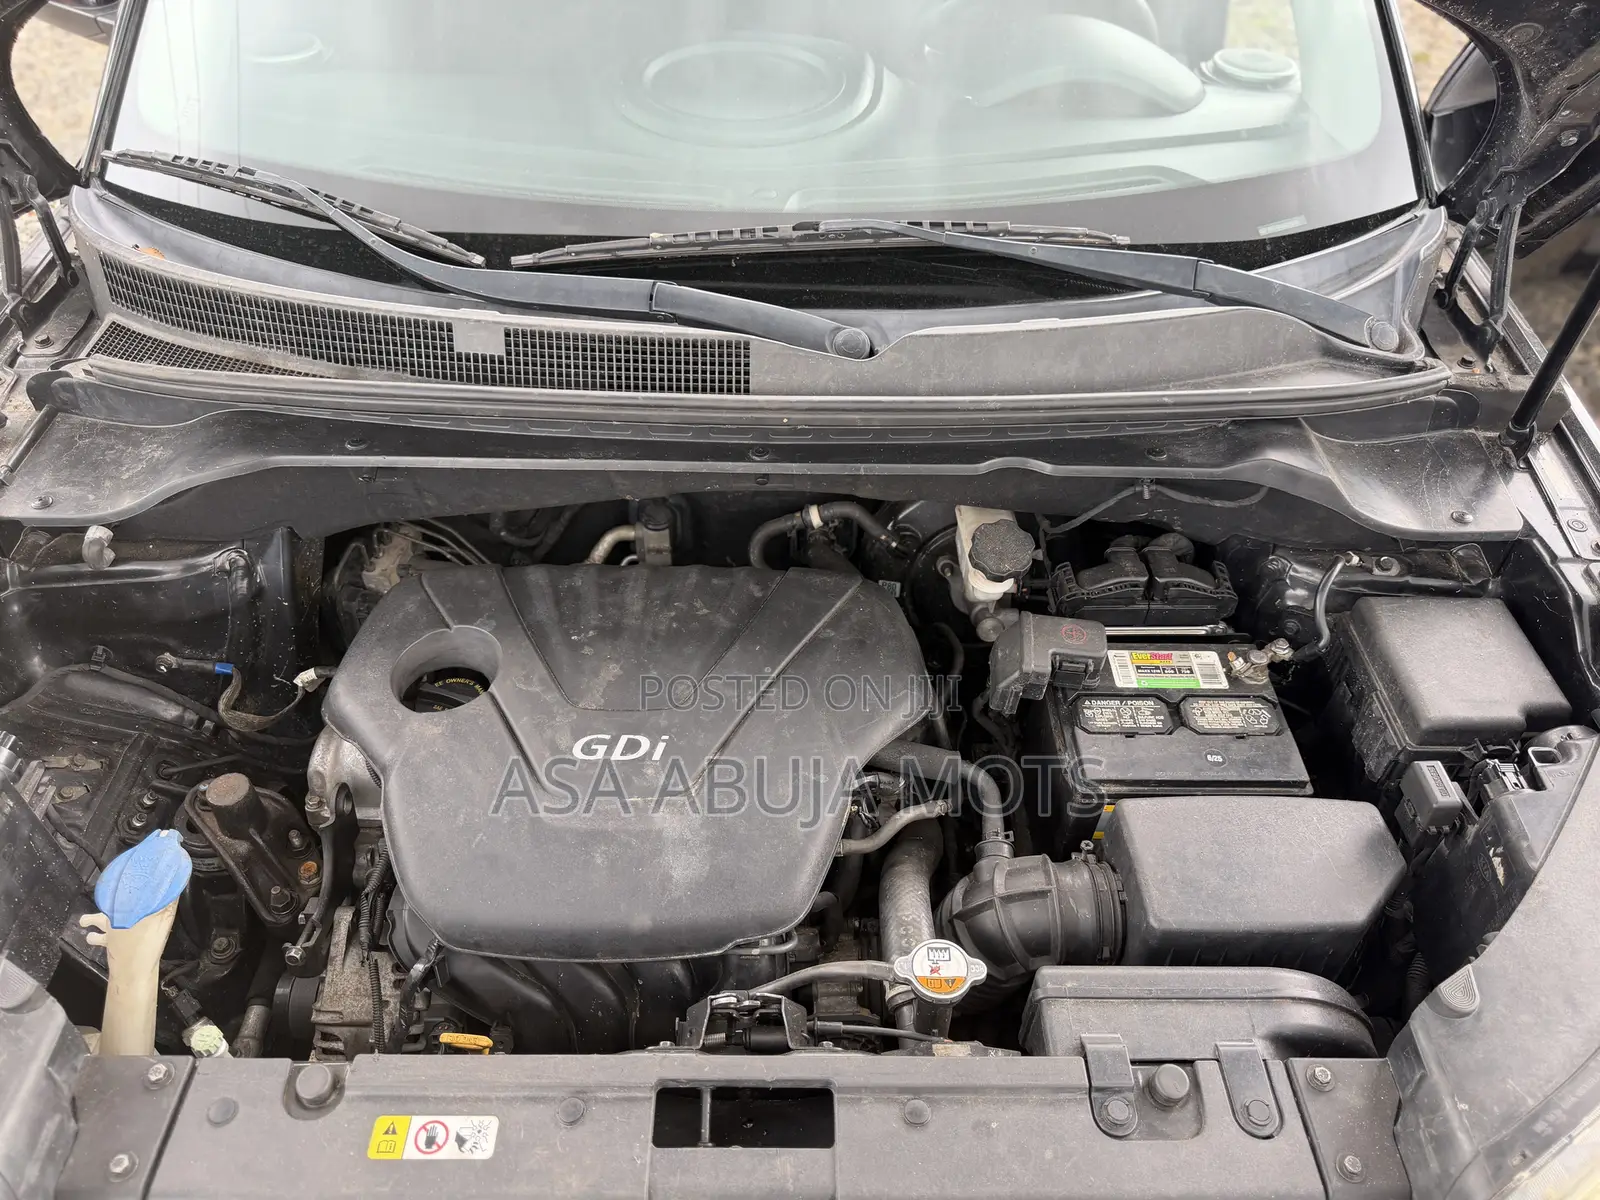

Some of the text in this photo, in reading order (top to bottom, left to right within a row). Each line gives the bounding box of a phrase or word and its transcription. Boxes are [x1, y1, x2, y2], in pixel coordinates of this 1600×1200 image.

[1131, 652, 1172, 660] EverStart
[446, 678, 474, 686] OWNER'S
[572, 734, 670, 761] GDi
